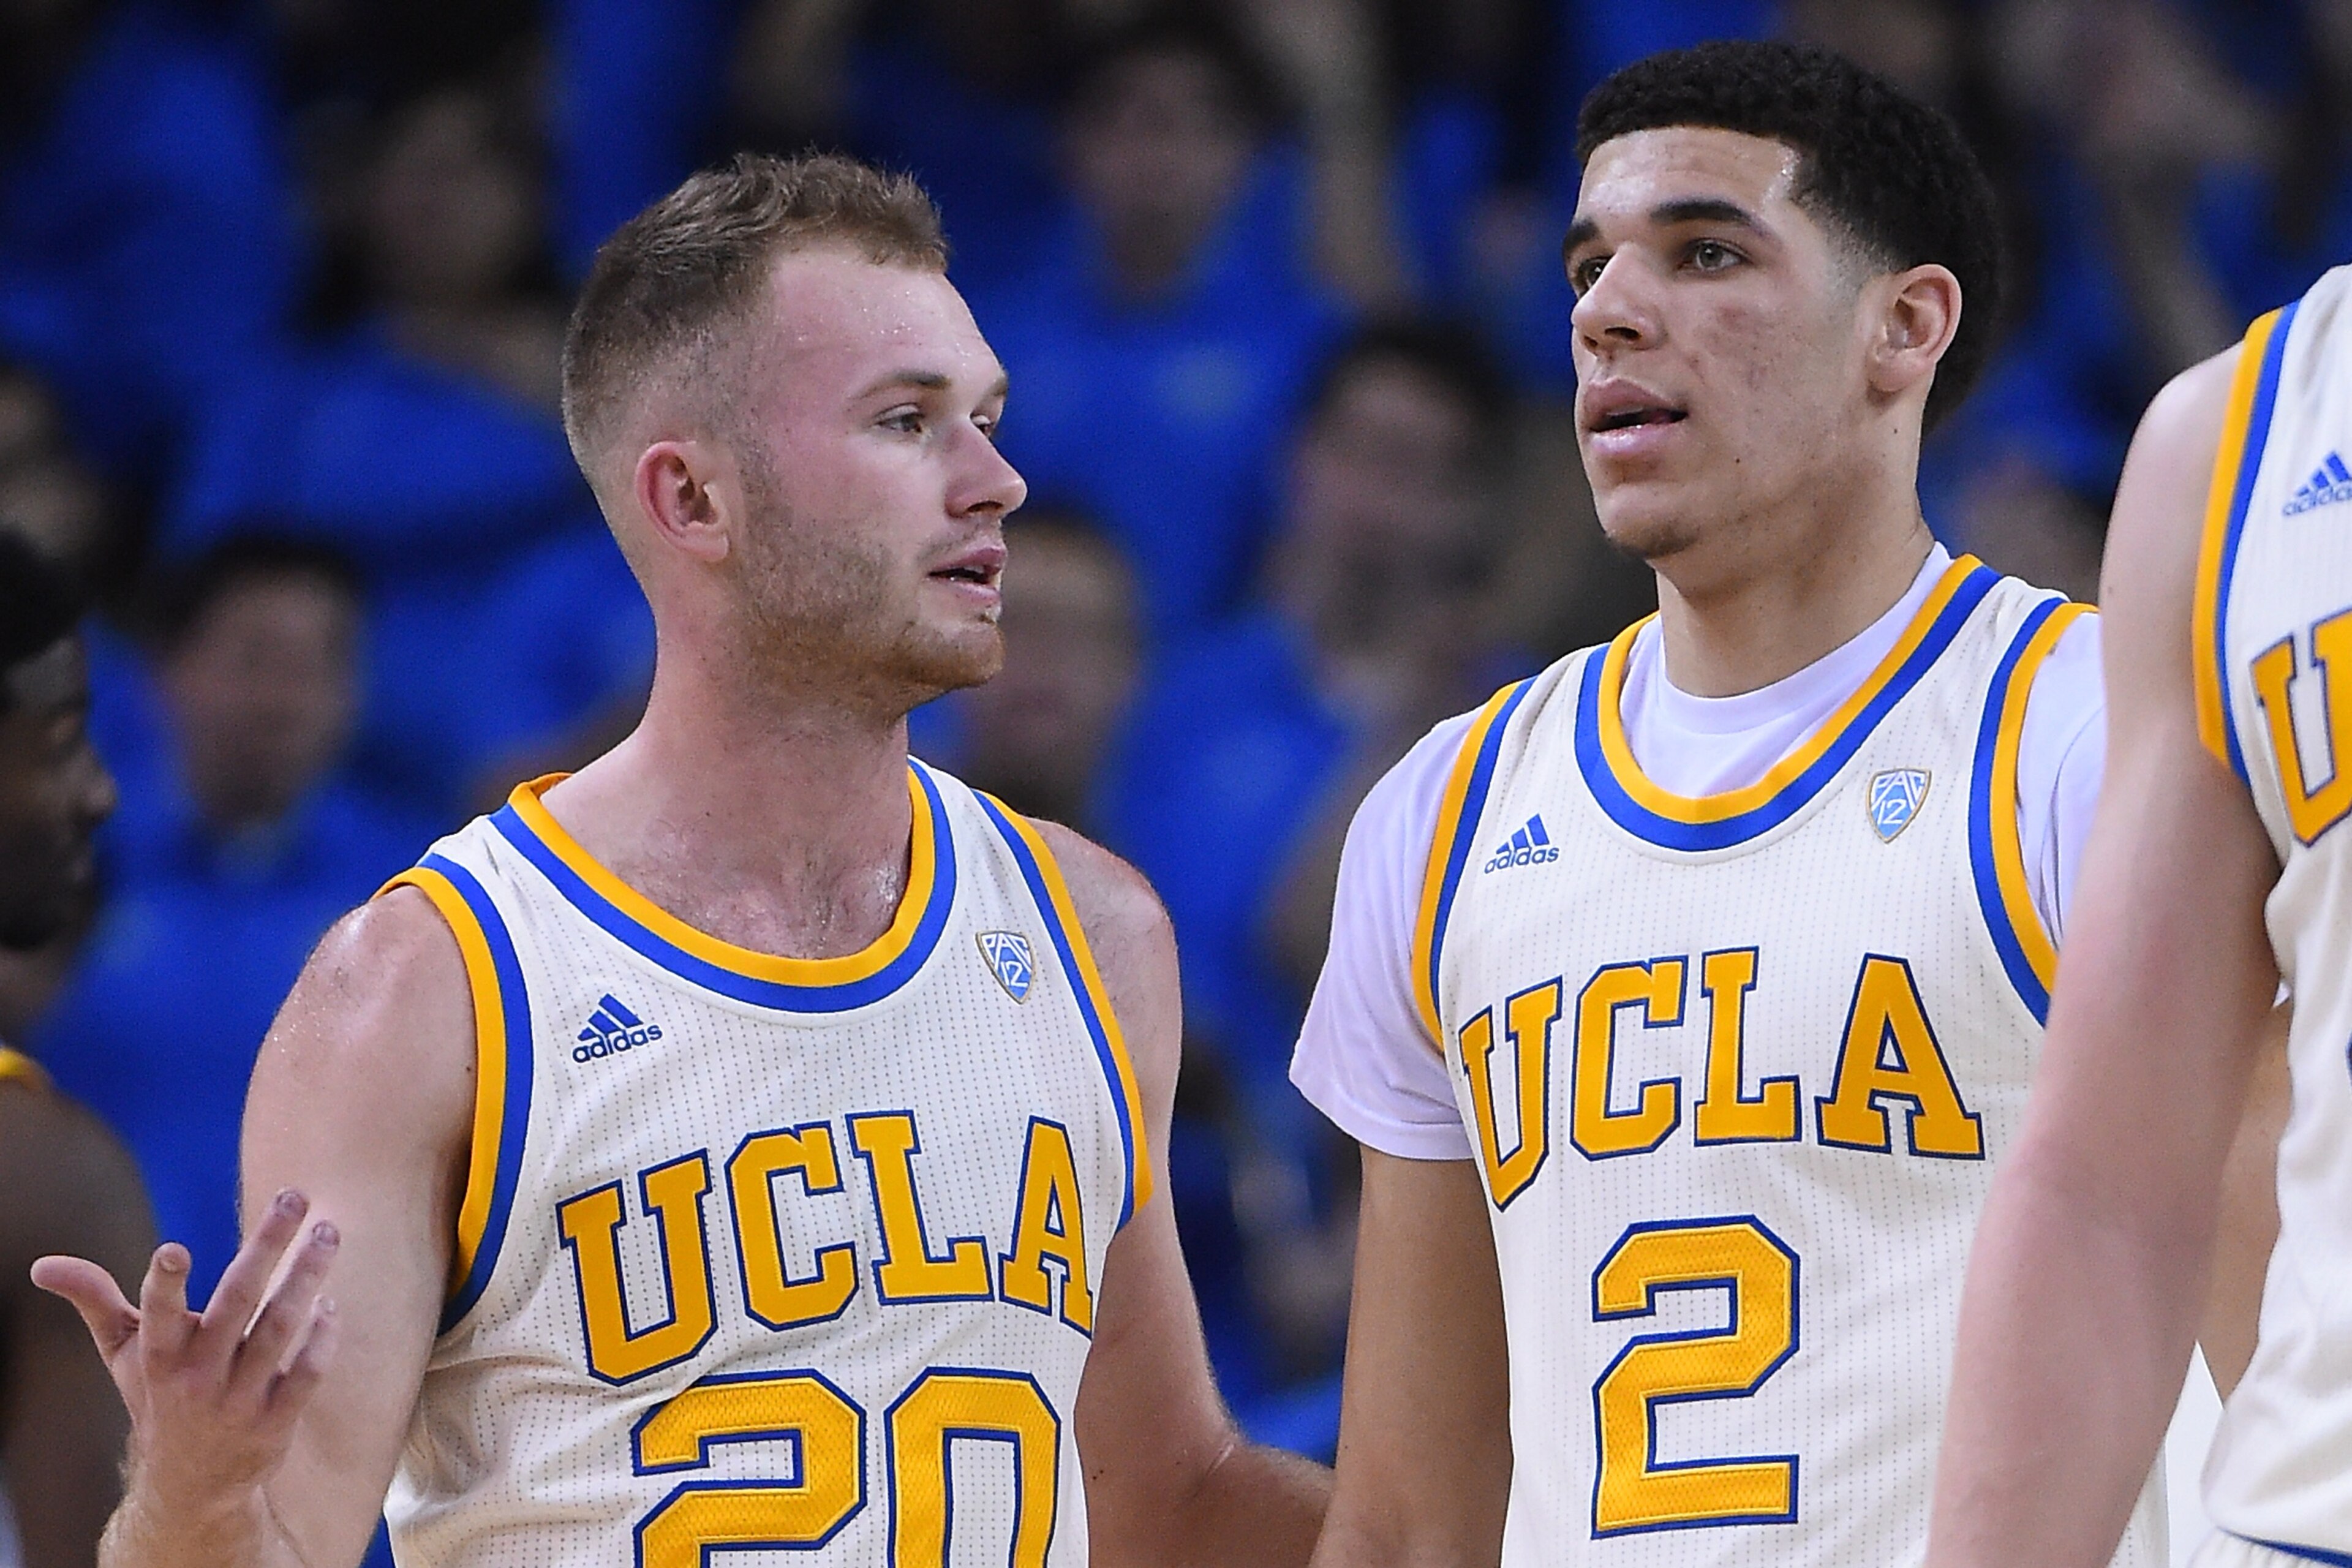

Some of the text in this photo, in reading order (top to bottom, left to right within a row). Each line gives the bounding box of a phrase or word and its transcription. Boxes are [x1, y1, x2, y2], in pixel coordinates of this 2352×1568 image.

[1871, 771, 1926, 812] PAC
[1877, 798, 1907, 825] 12
[1484, 846, 1559, 874] adidas
[1000, 960, 1029, 987] 12
[572, 1024, 663, 1063] adidas
[1458, 946, 1985, 1212] UCLA
[556, 1110, 1093, 1386] UCLA
[1591, 1214, 1800, 1540] 2
[630, 1366, 1061, 1568] 20
